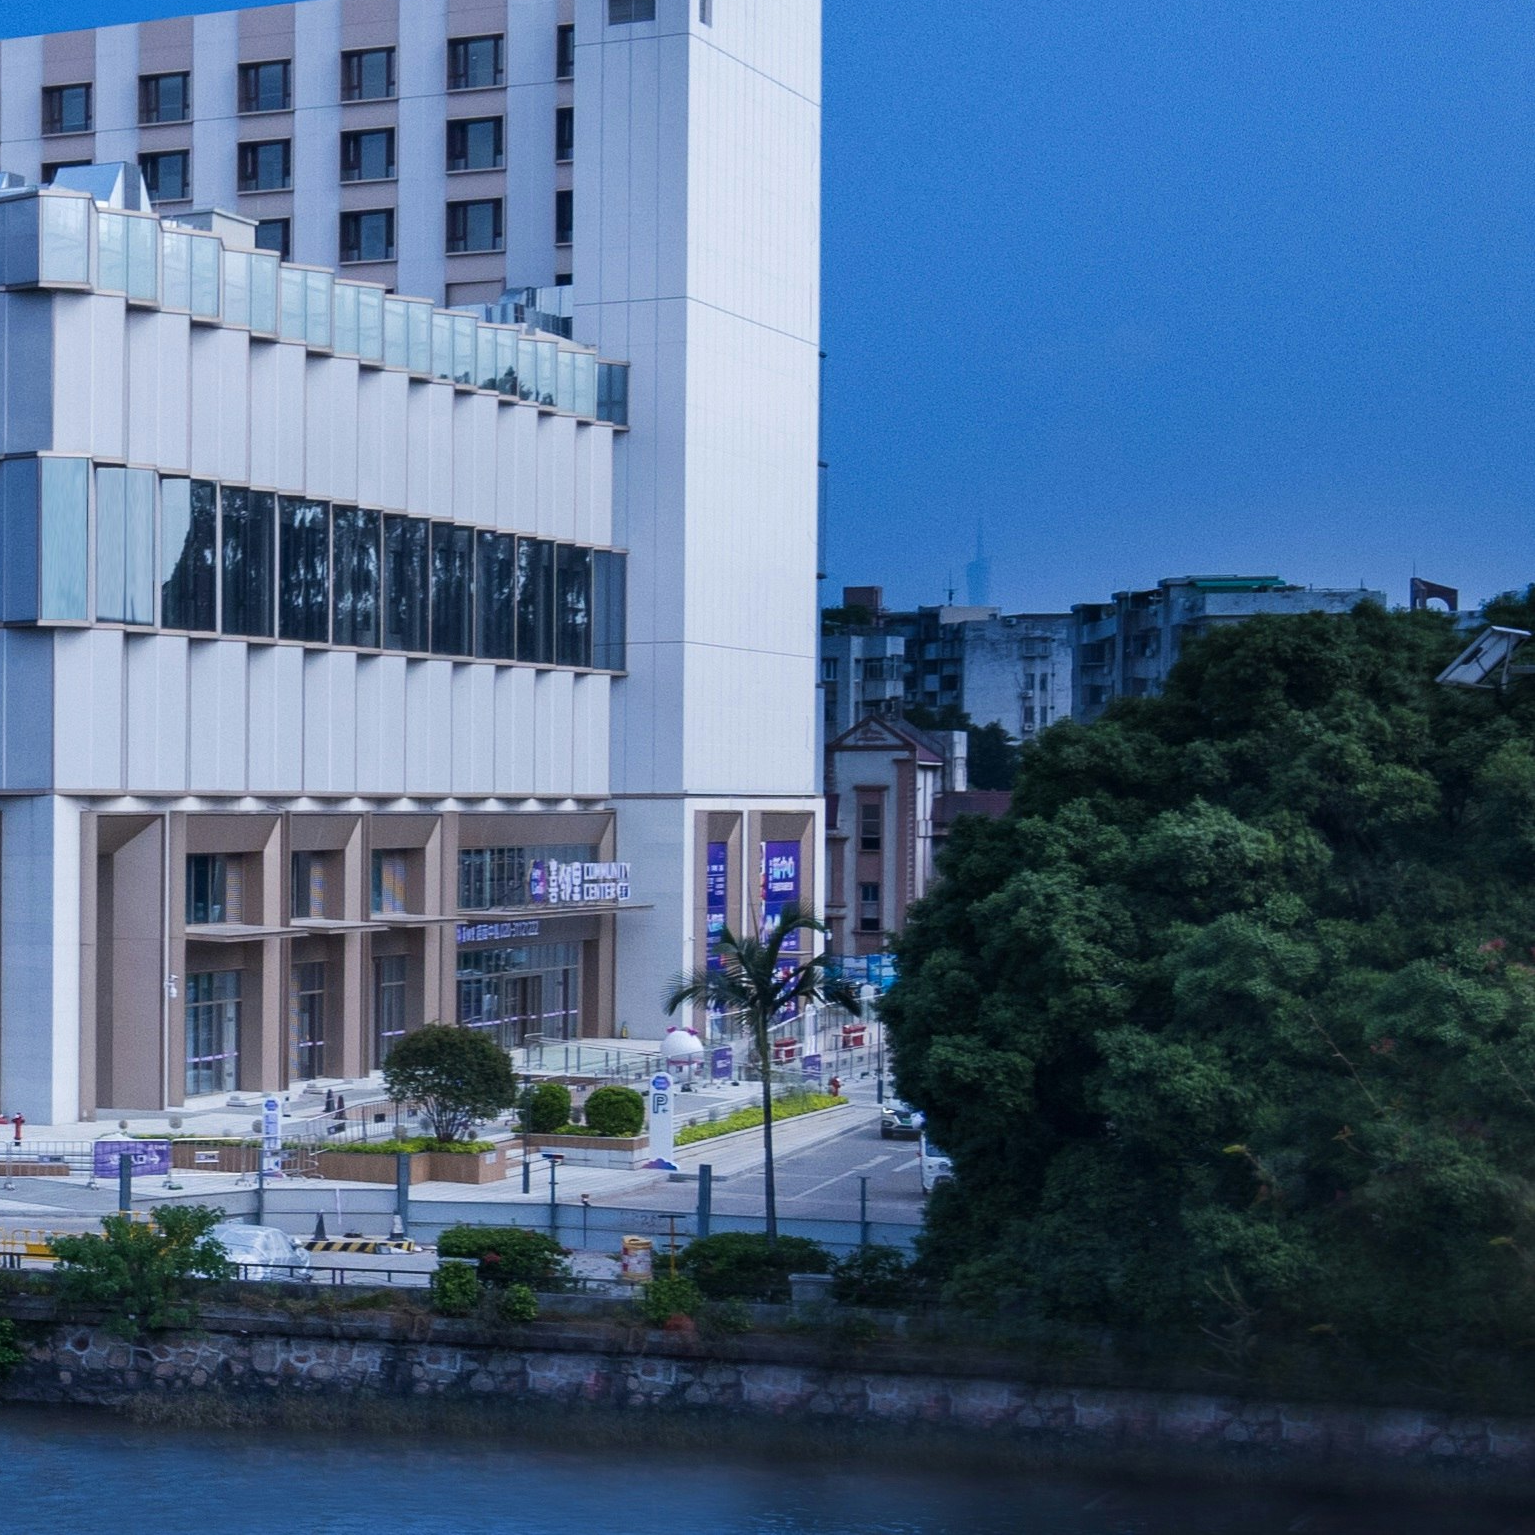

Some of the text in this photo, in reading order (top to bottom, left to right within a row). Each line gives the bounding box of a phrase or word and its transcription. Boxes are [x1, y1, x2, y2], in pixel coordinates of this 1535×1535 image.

[583, 862, 631, 881] COMMUNITY
[583, 882, 617, 901] CENTER
[653, 1093, 668, 1114] P
